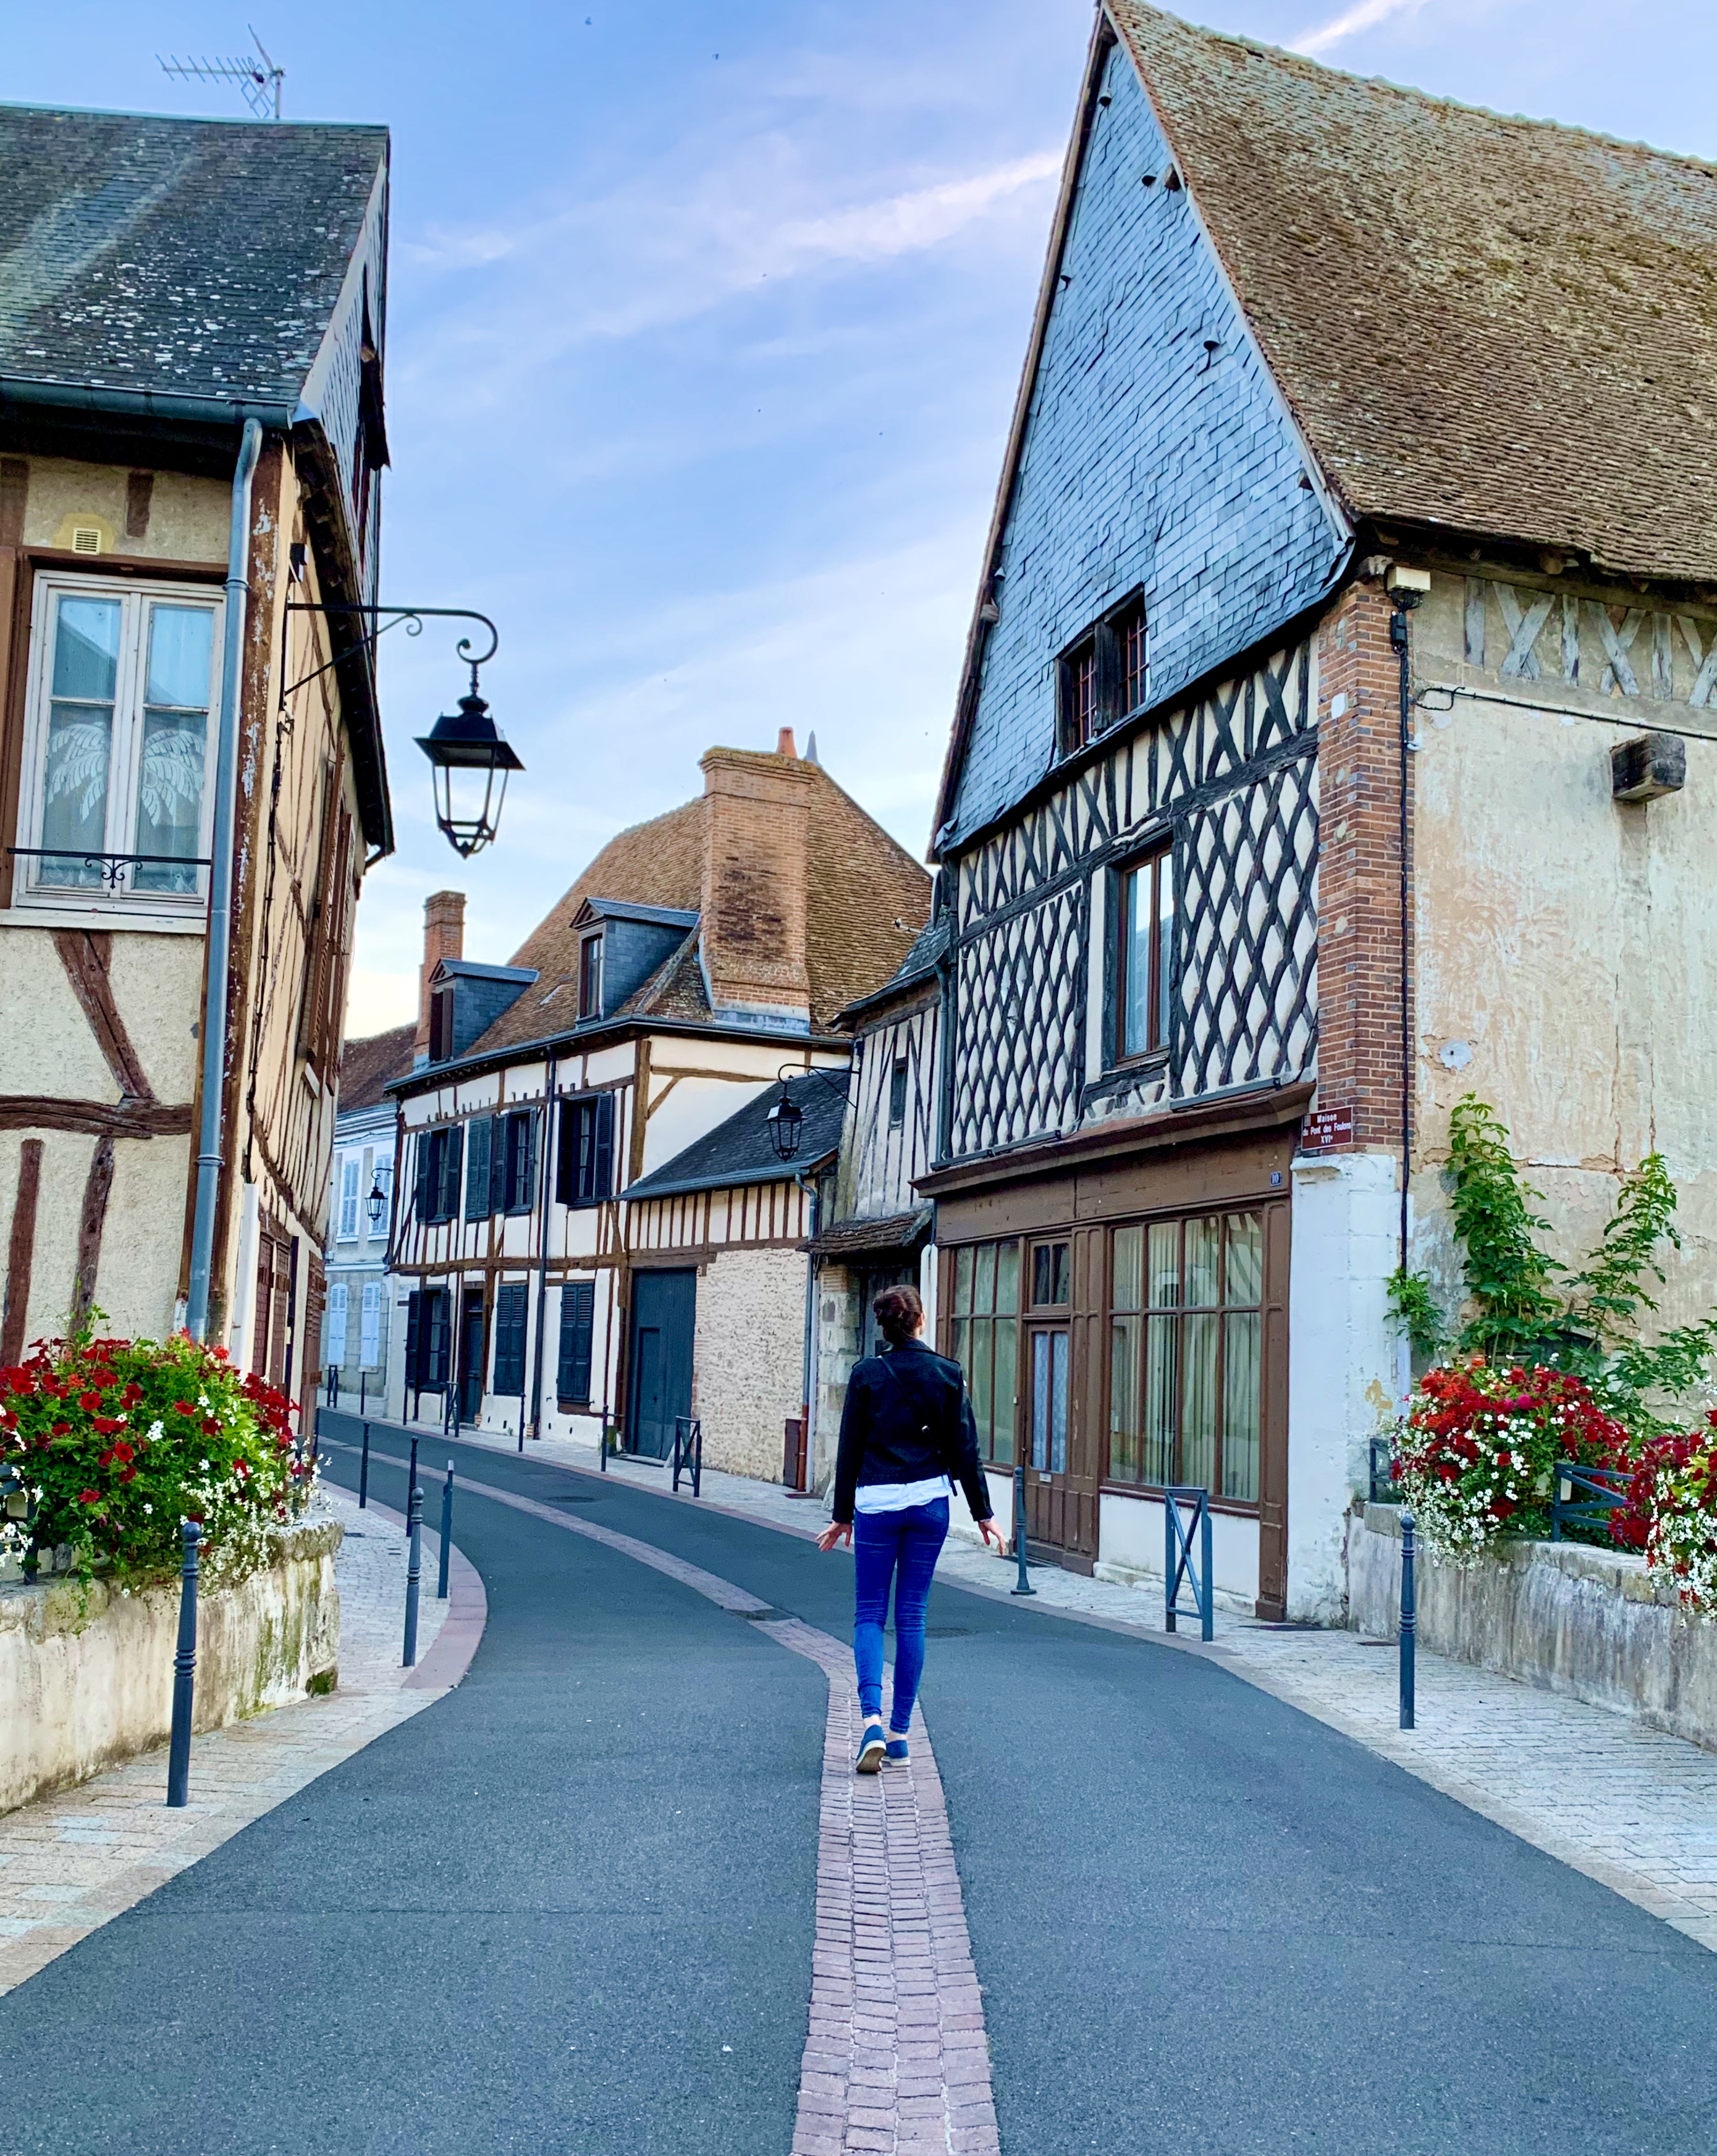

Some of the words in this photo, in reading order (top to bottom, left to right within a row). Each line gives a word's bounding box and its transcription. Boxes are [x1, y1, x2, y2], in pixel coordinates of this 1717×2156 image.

[1317, 1114, 1337, 1123] Maison
[1310, 1126, 1321, 1135] Pont
[1323, 1124, 1331, 1133] des
[1334, 1122, 1351, 1131] Foulons
[1272, 1173, 1279, 1184] 10
